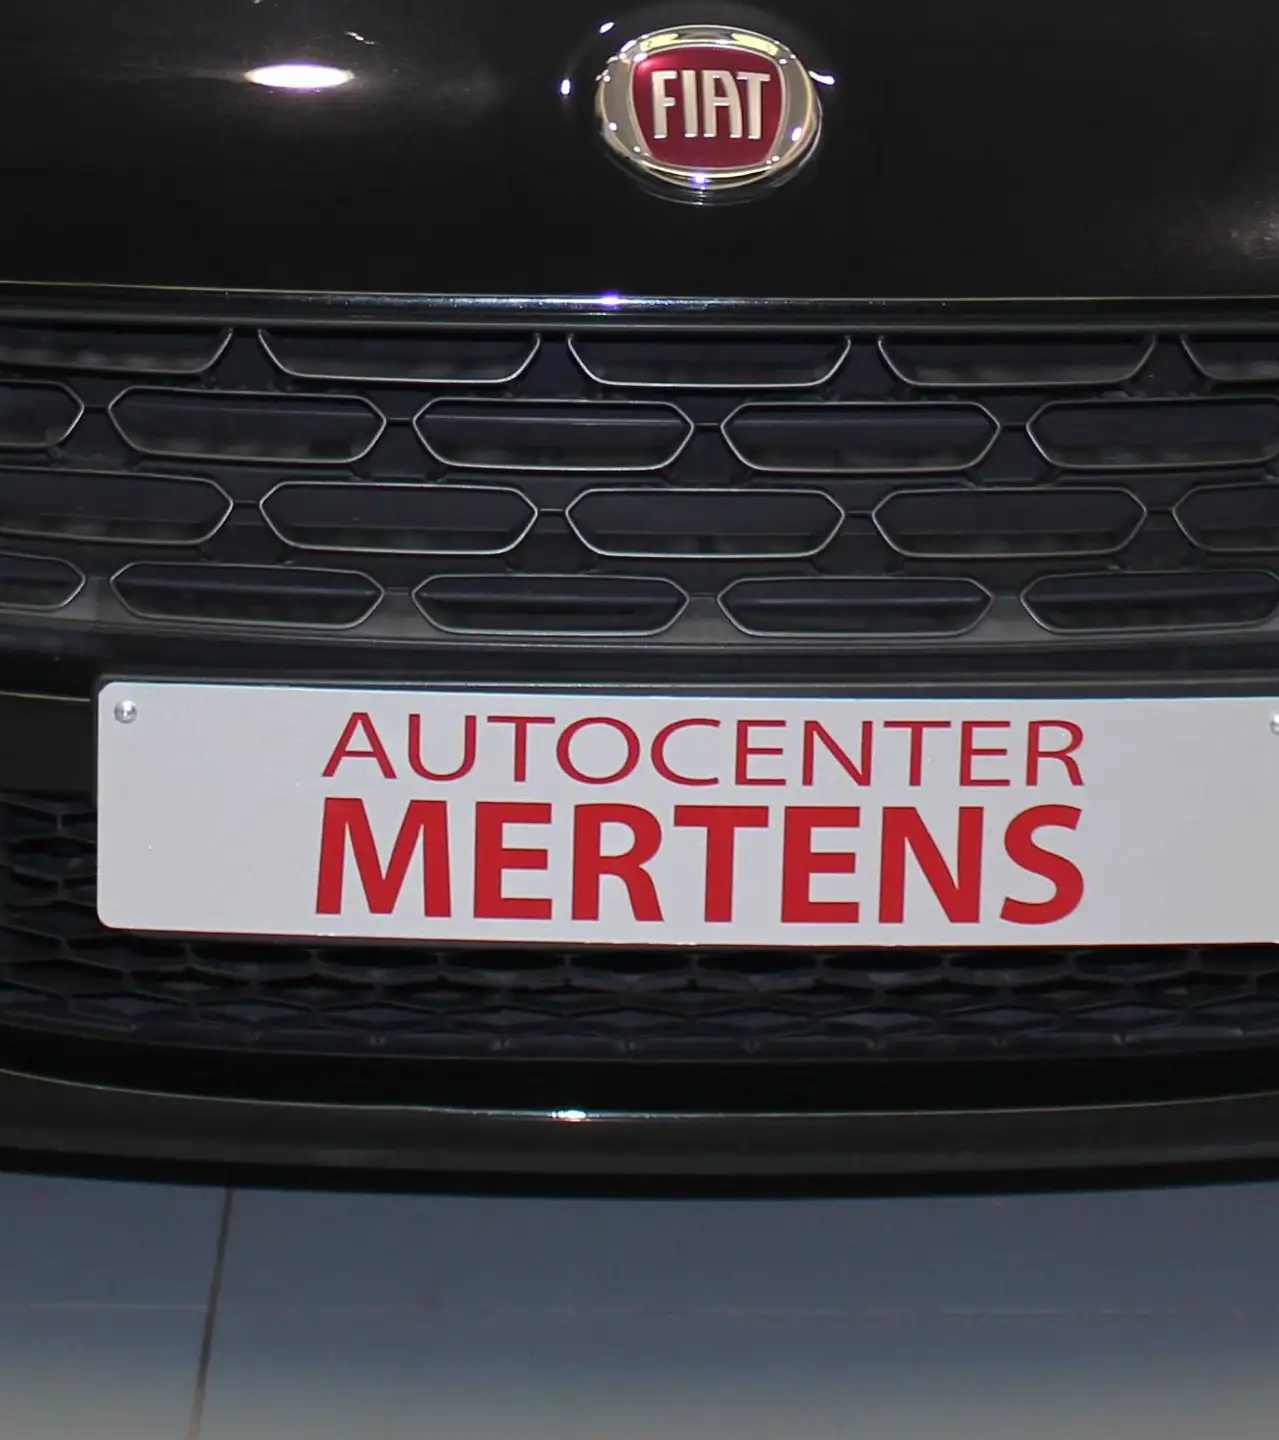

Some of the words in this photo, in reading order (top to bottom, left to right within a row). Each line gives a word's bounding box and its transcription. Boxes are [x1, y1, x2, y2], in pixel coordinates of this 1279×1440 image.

[651, 69, 771, 140] FIAT
[322, 711, 1086, 788] AUTOCENTER
[315, 796, 1086, 926] MERTENS
